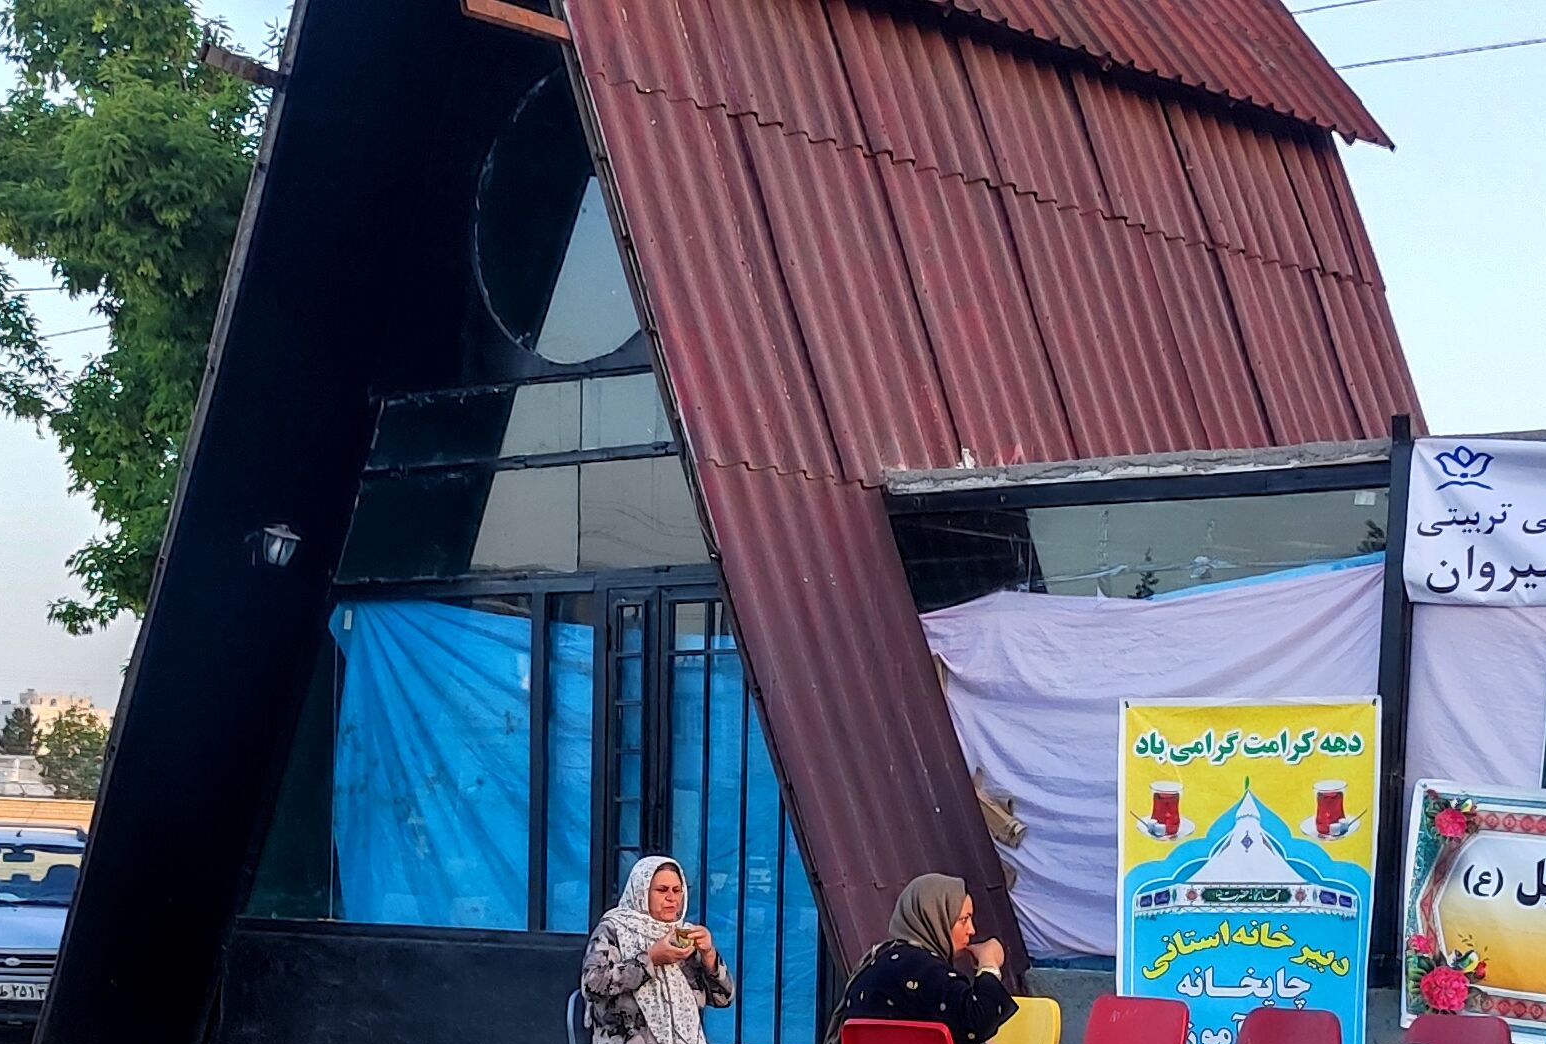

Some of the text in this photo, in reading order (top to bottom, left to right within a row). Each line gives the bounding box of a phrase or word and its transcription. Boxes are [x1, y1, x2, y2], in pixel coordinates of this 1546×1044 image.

[1416, 503, 1513, 537] تربیتی
[1135, 730, 1363, 763] دهه کرامت گرامی باد
[1461, 862, 1505, 899] (ع)
[1142, 920, 1230, 980] استانی
[1176, 966, 1312, 1010] چایخانه
